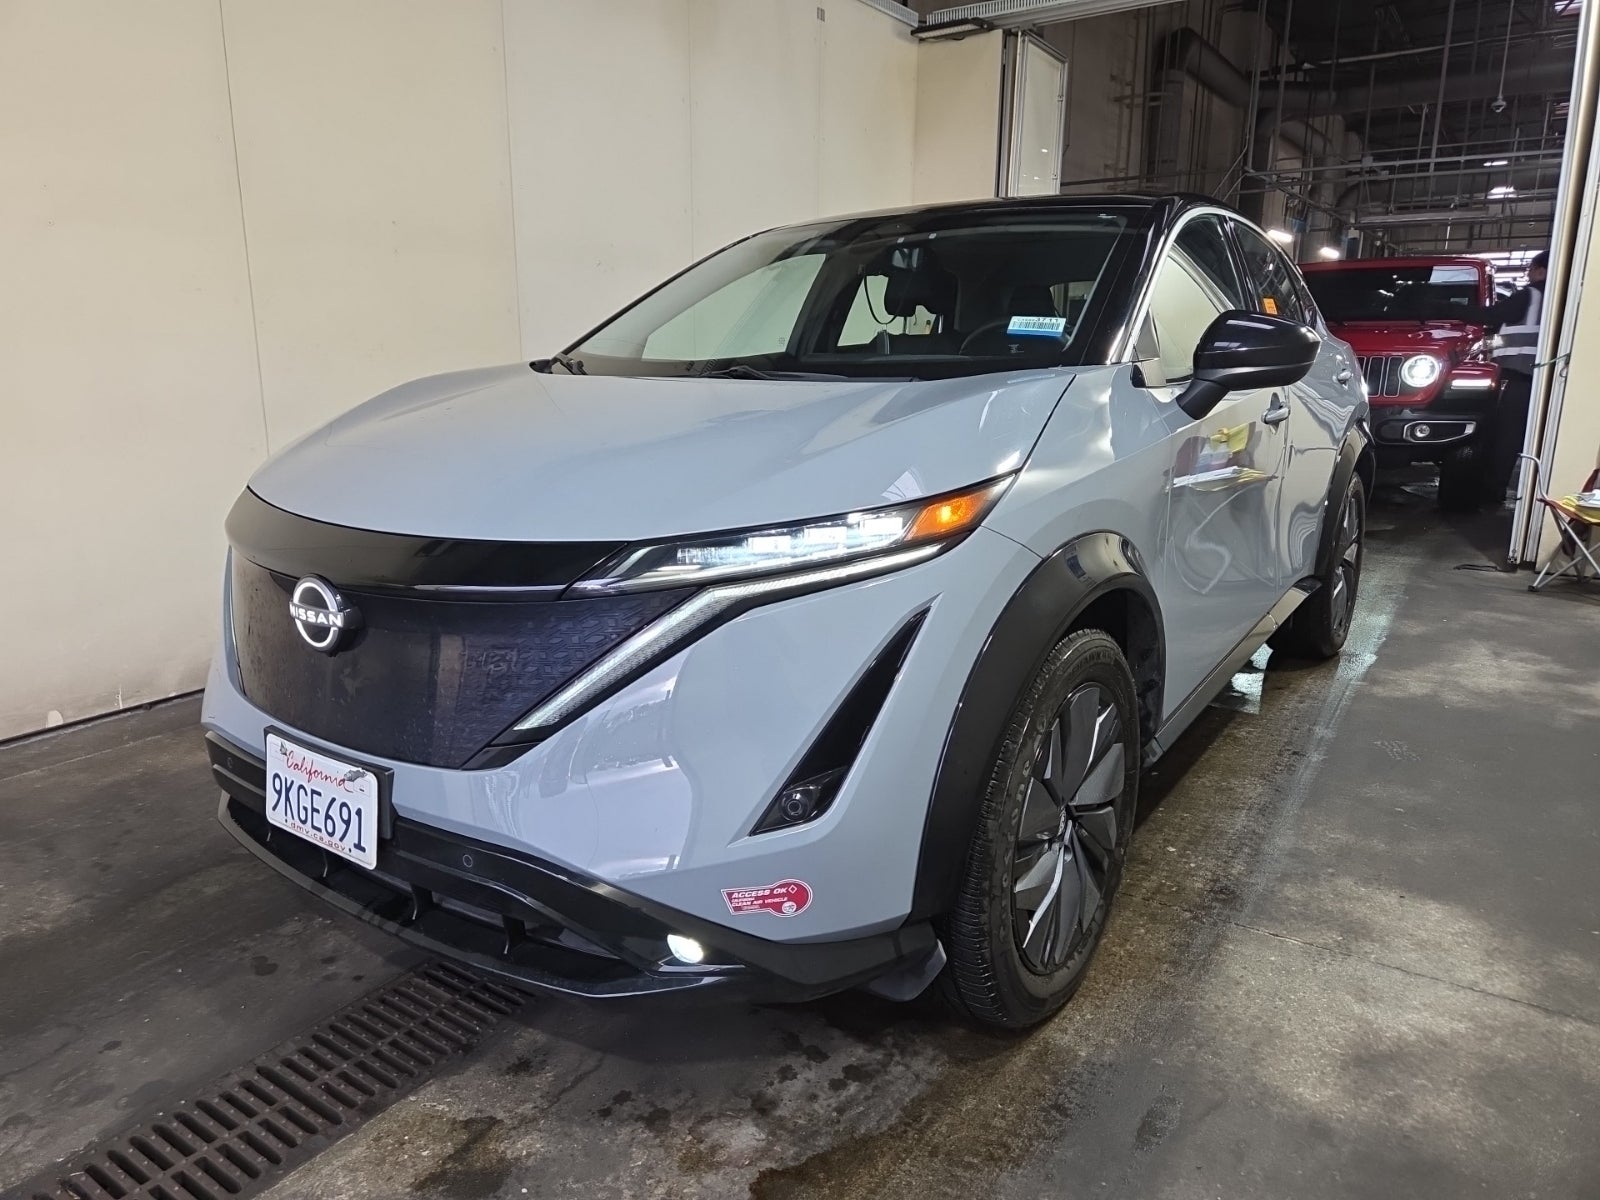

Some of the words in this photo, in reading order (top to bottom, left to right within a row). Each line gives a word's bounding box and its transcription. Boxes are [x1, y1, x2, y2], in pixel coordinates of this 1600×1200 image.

[289, 603, 343, 627] NISSAN
[286, 750, 353, 793] California
[272, 772, 366, 853] 9KGE691
[291, 822, 346, 851] dmv.ca.gov
[731, 889, 770, 898] ACCESS
